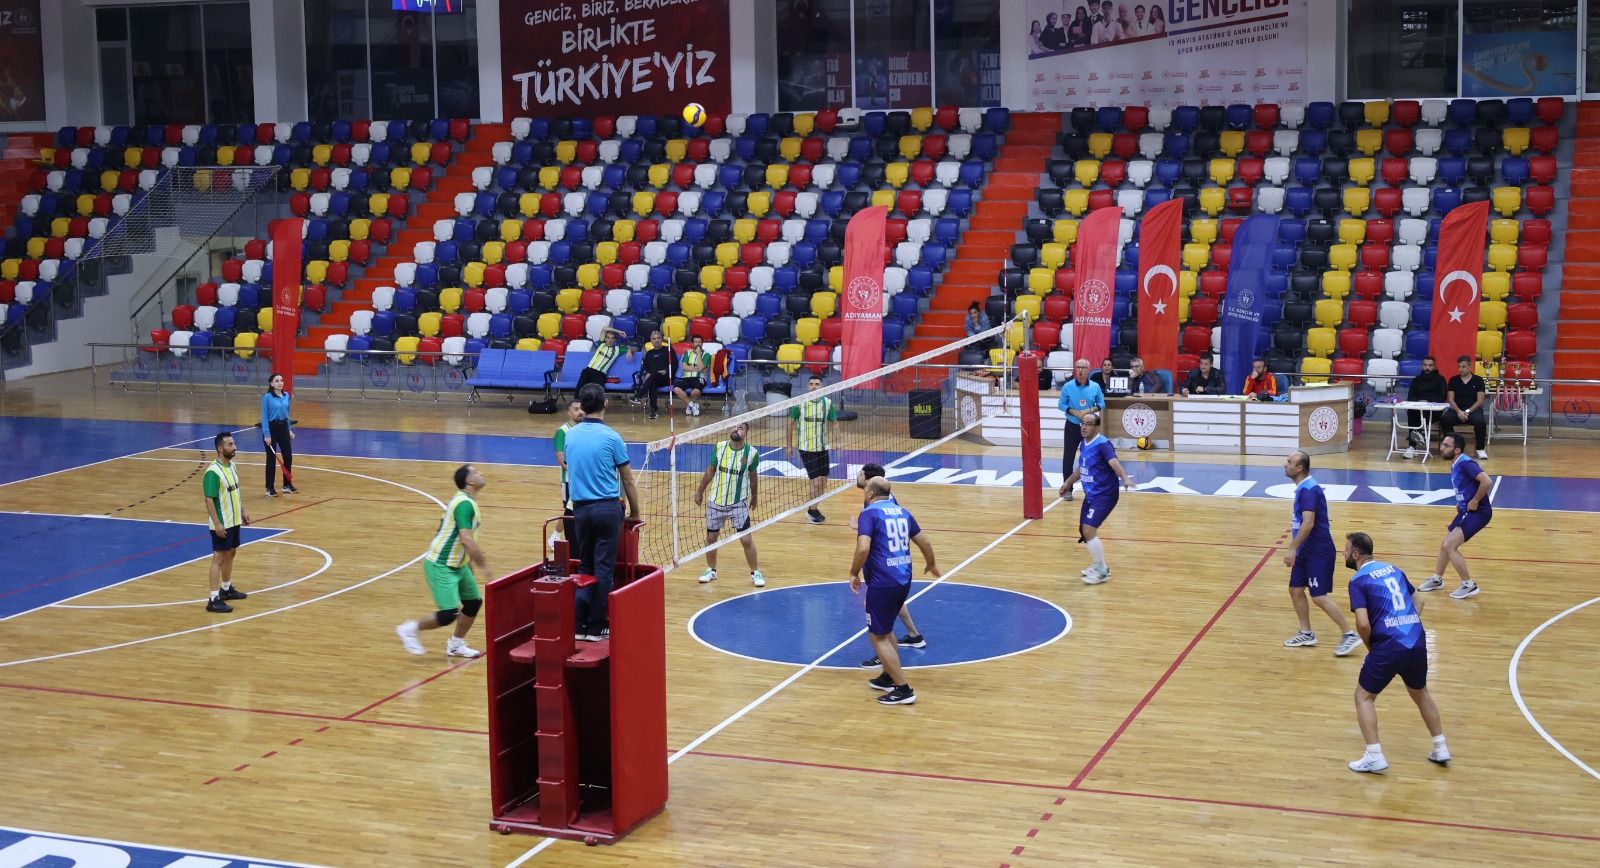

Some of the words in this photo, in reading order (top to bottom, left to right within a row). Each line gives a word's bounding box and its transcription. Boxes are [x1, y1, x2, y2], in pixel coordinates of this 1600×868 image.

[561, 17, 657, 54] BİRLİKTE
[1233, 27, 1251, 36] ANMA
[512, 43, 717, 110] TÜRKİYE'YİZ
[845, 312, 882, 320] ADIYAMAN
[1074, 316, 1112, 325] ADIYAMAN
[1086, 508, 1095, 519] 3
[885, 517, 910, 553] 99
[1308, 577, 1319, 588] 44
[1383, 576, 1406, 611] 8
